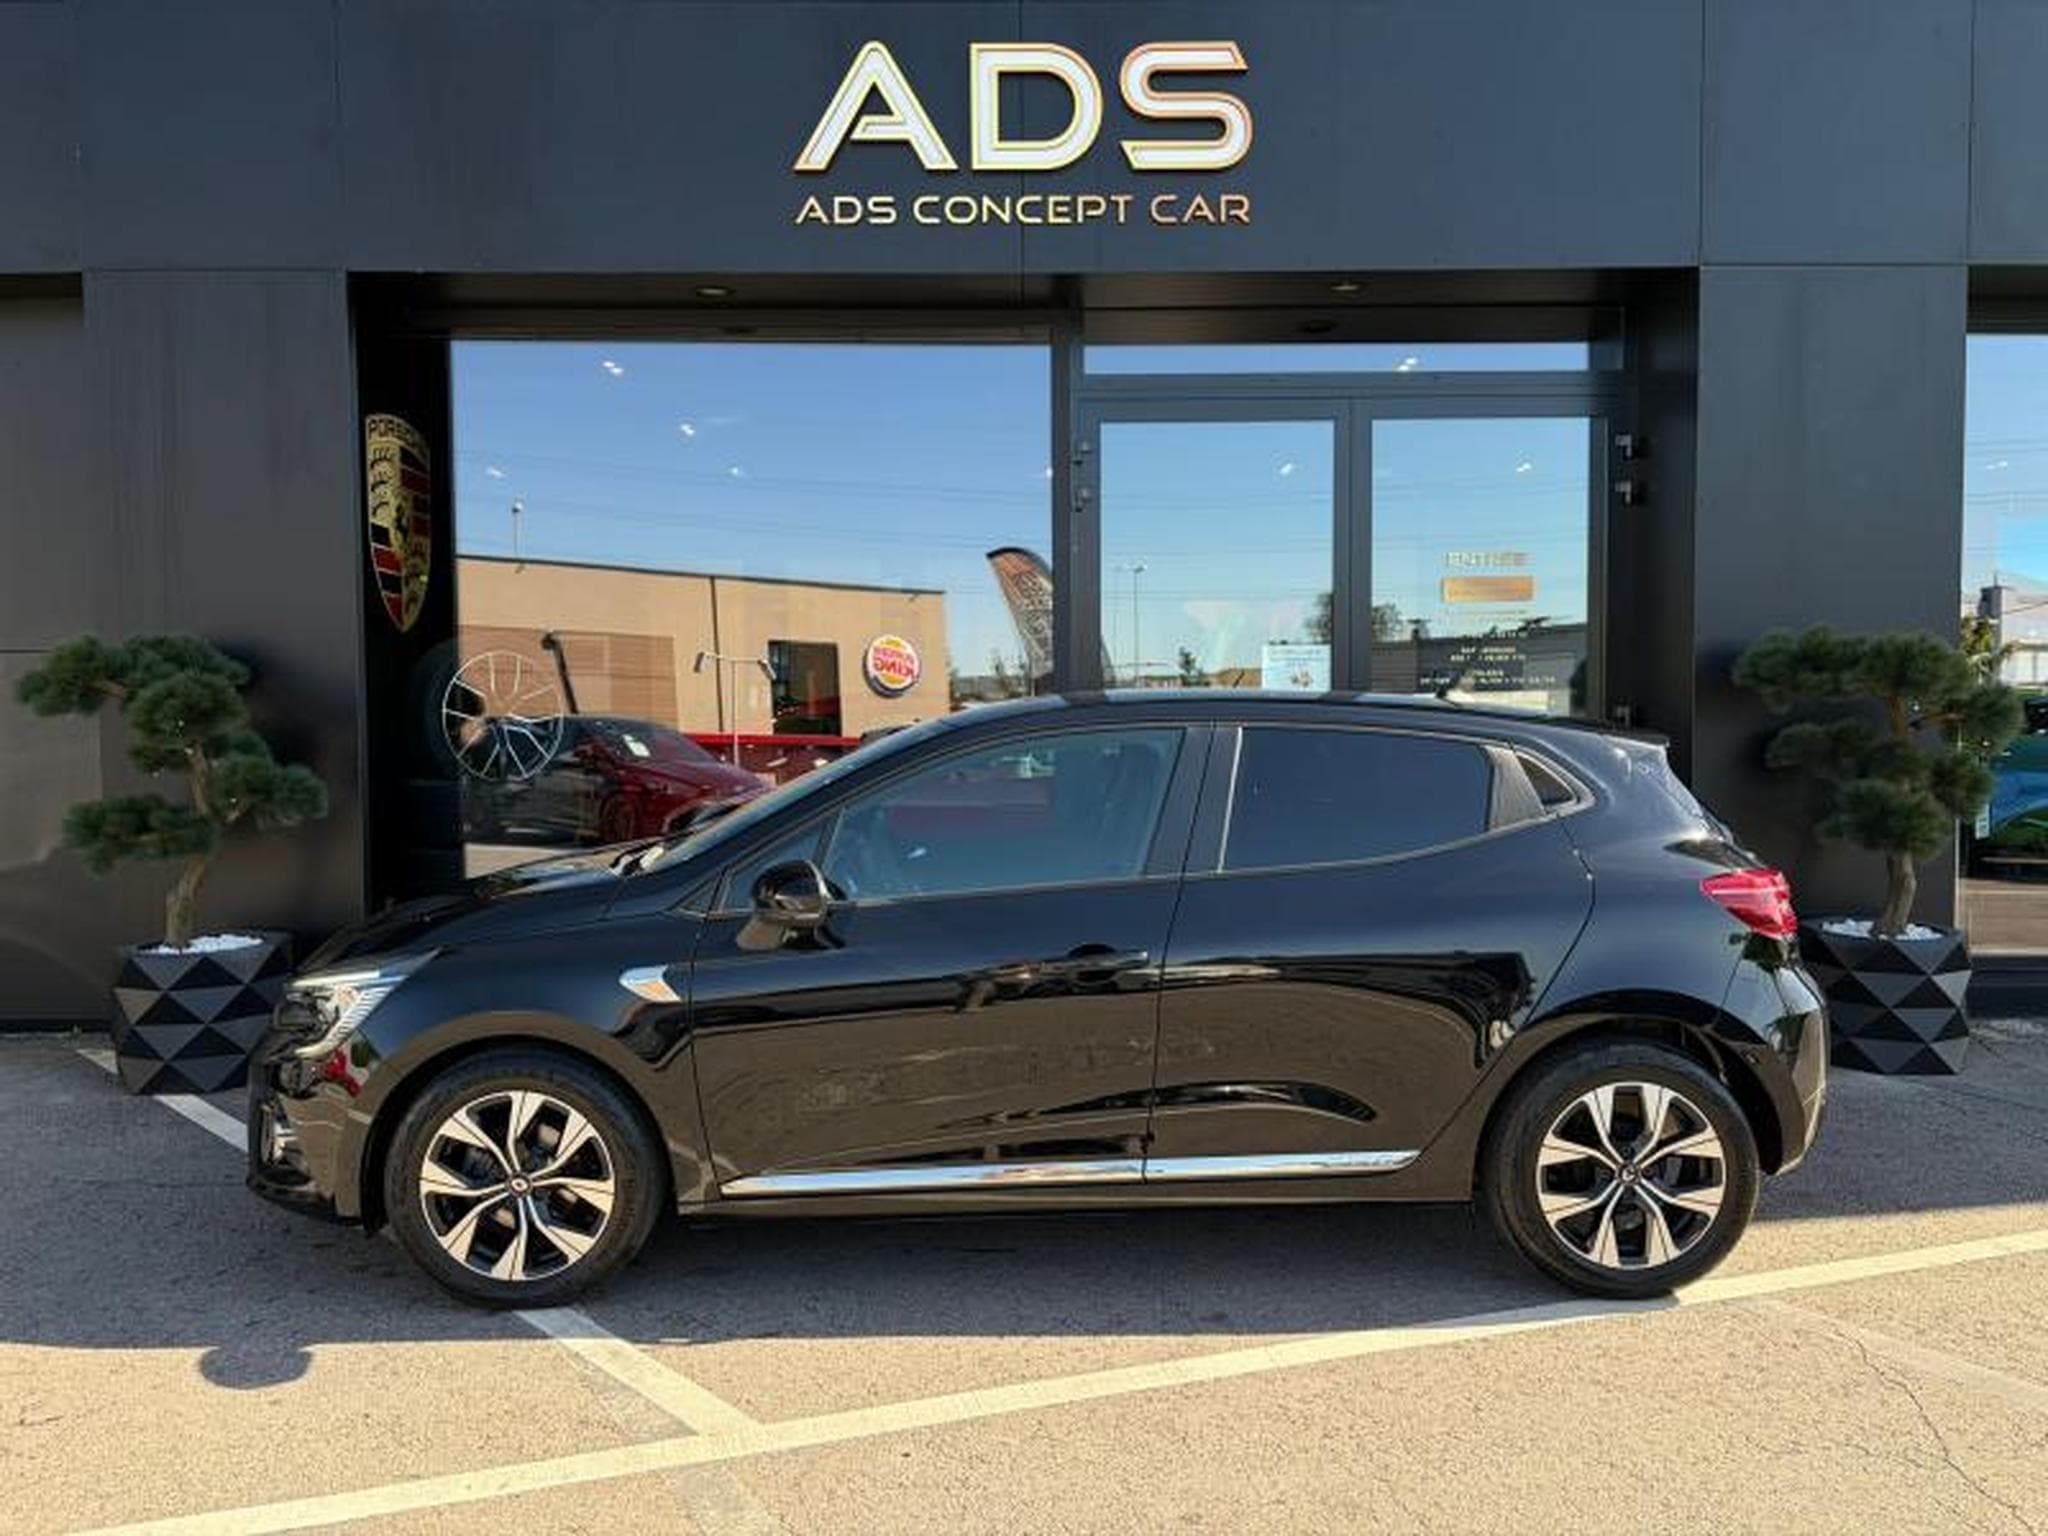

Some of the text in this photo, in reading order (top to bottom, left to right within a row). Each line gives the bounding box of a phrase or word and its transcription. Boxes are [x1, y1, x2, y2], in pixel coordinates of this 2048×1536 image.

[794, 41, 1254, 171] ADS
[795, 194, 1251, 225] ADS CONCEPT CAR
